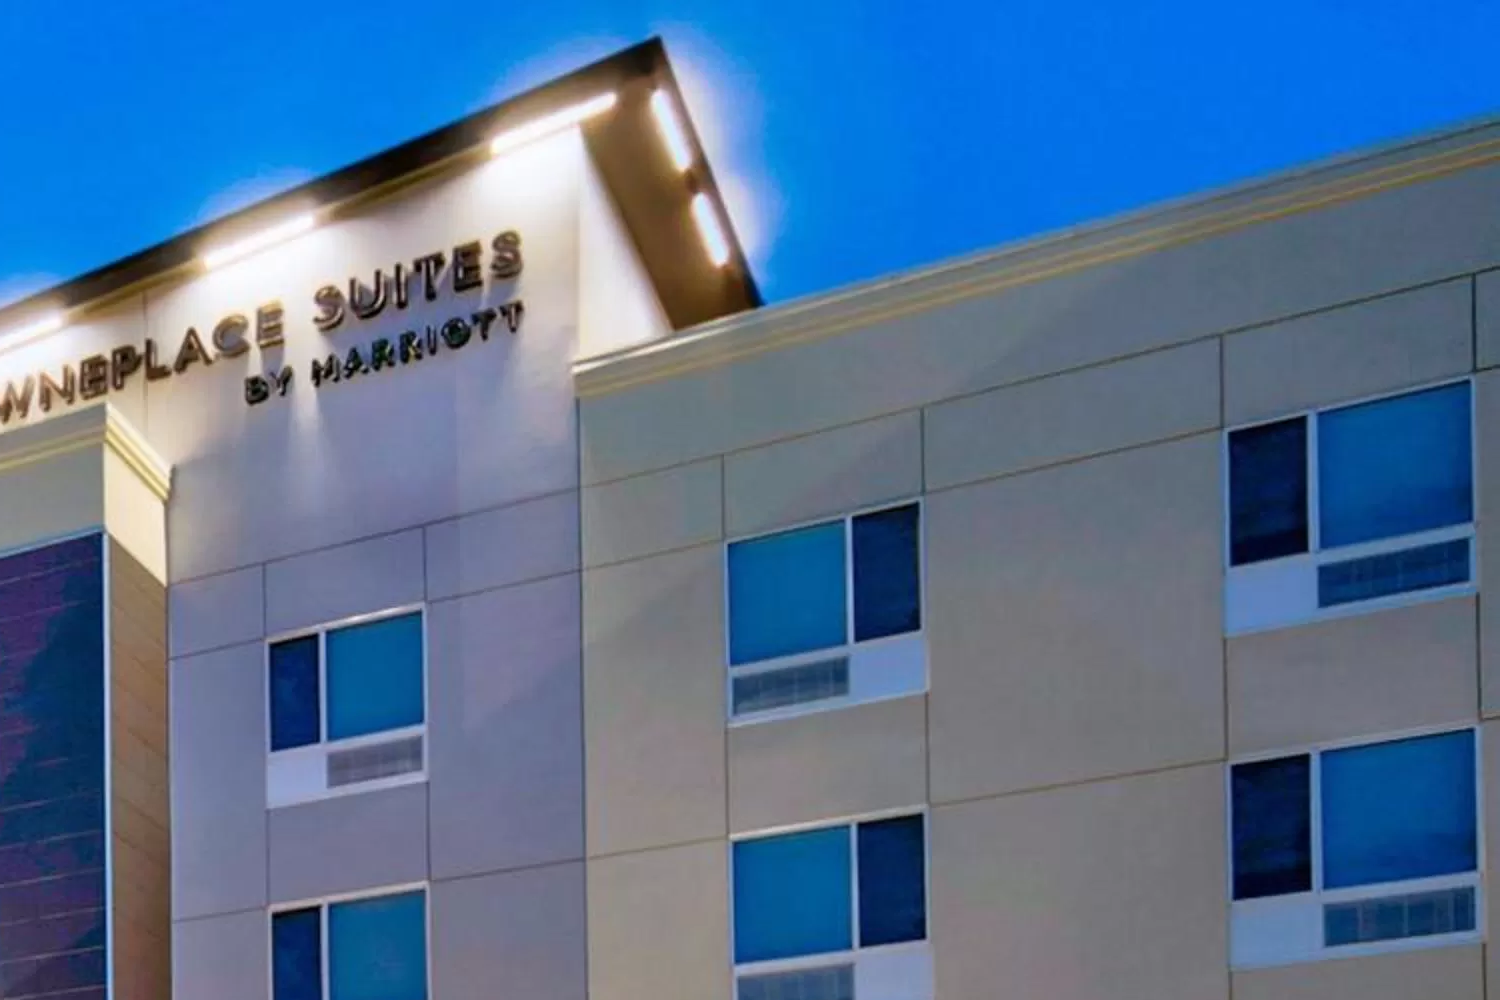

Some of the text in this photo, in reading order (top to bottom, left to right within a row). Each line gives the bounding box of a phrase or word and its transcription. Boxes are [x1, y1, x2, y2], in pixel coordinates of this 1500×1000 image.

[313, 230, 523, 331] SUITES
[244, 300, 524, 406] BY MARRIOTT
